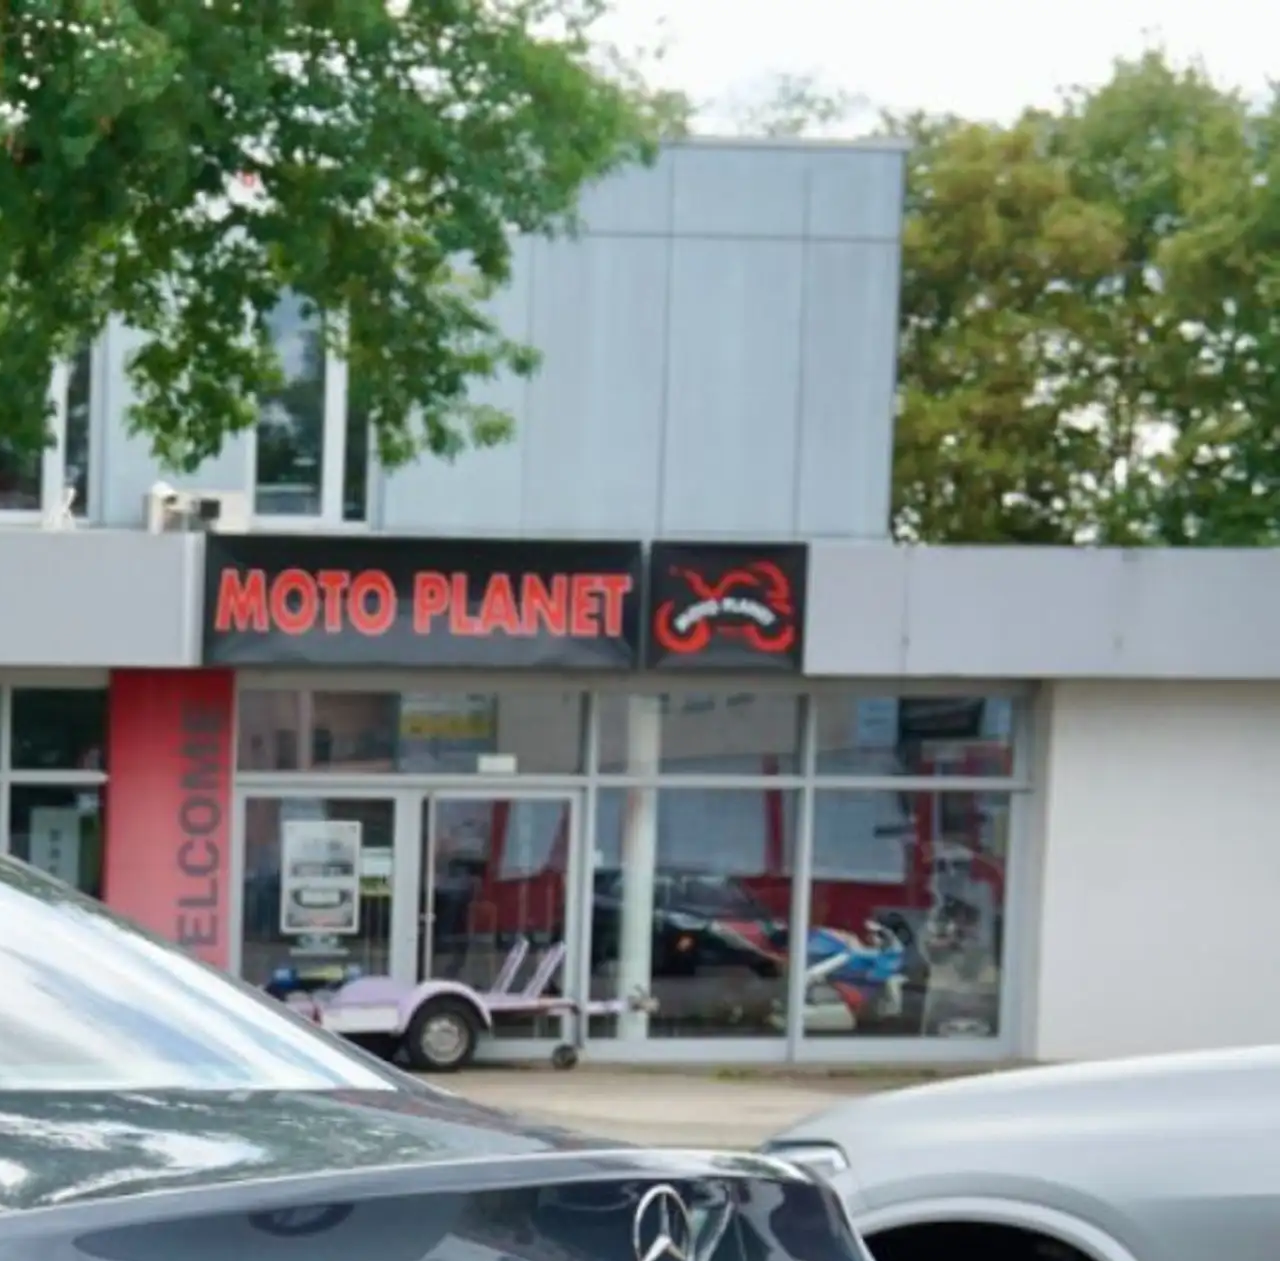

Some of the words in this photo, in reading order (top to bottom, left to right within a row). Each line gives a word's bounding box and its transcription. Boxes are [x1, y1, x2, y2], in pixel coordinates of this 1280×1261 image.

[214, 567, 398, 636] MOTO
[412, 571, 632, 638] PLANET
[176, 699, 222, 960] ELCOME
